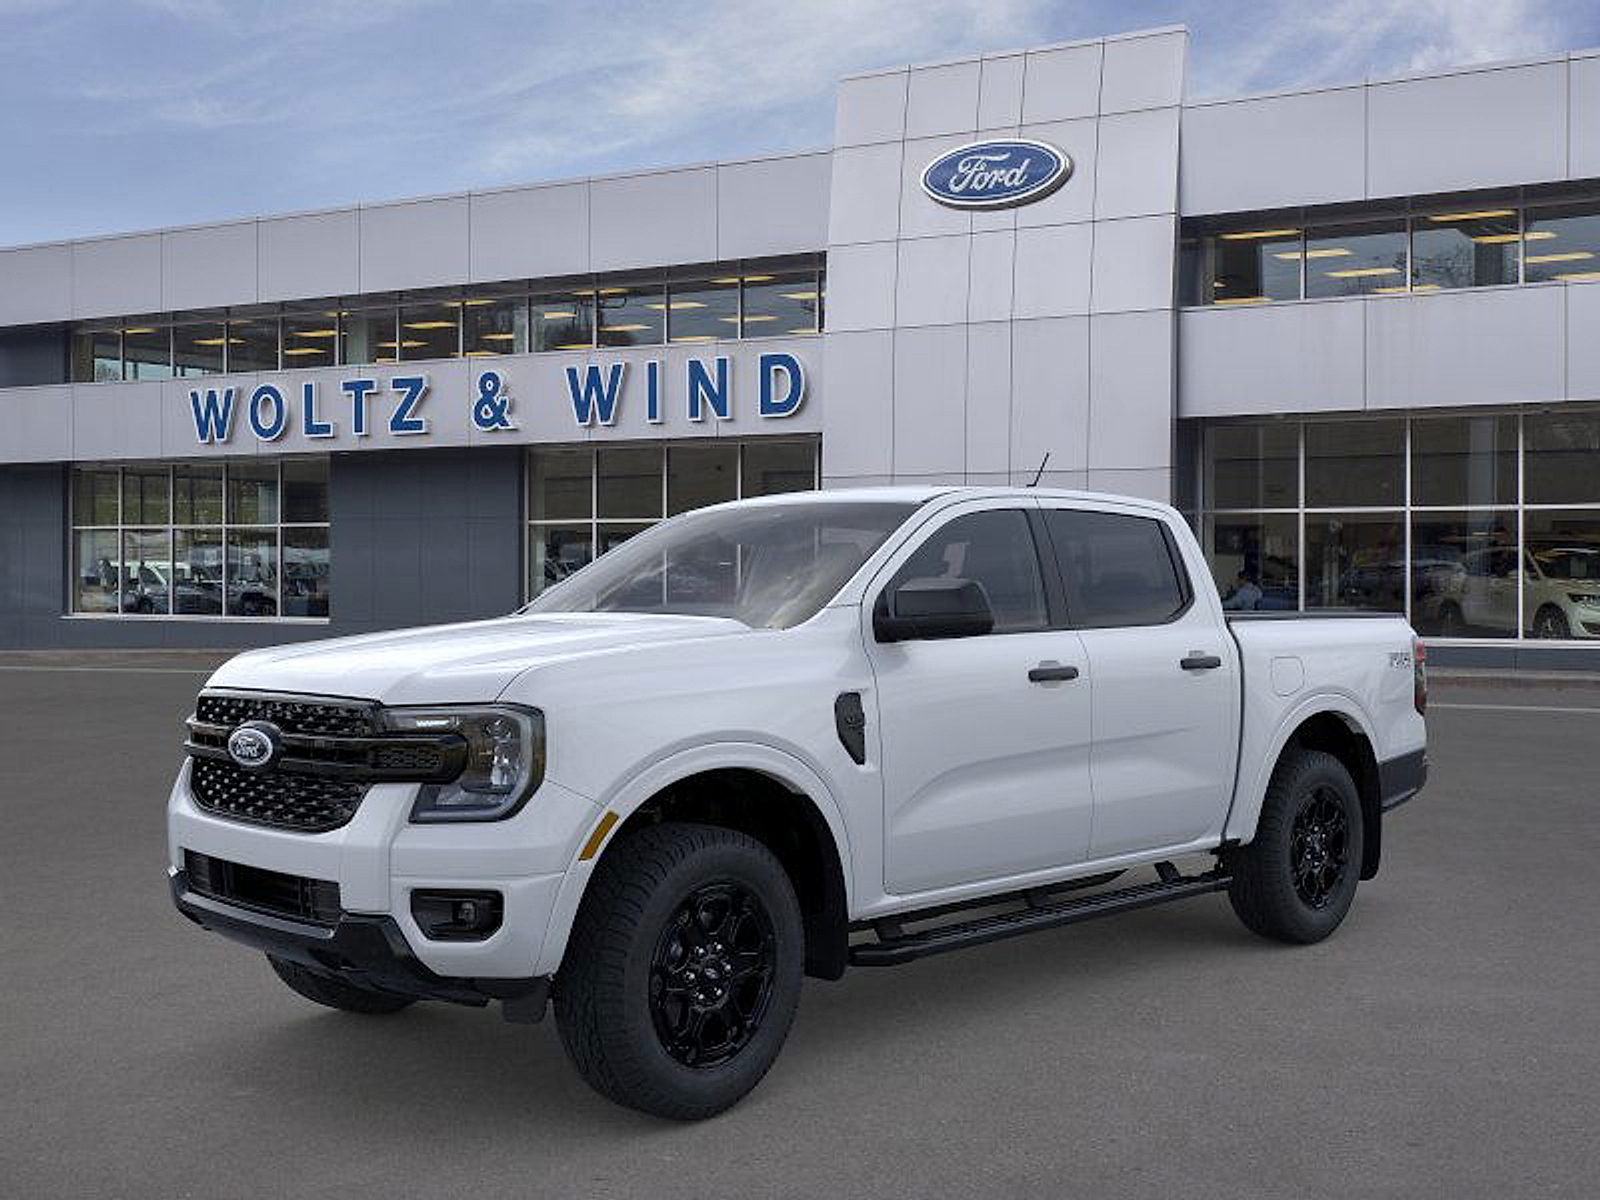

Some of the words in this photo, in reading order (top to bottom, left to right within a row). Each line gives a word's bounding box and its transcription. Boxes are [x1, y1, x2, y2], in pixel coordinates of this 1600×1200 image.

[949, 151, 1031, 194] Ford
[189, 373, 430, 444] WOLTZ
[472, 370, 511, 431] &
[566, 352, 806, 426] WIND
